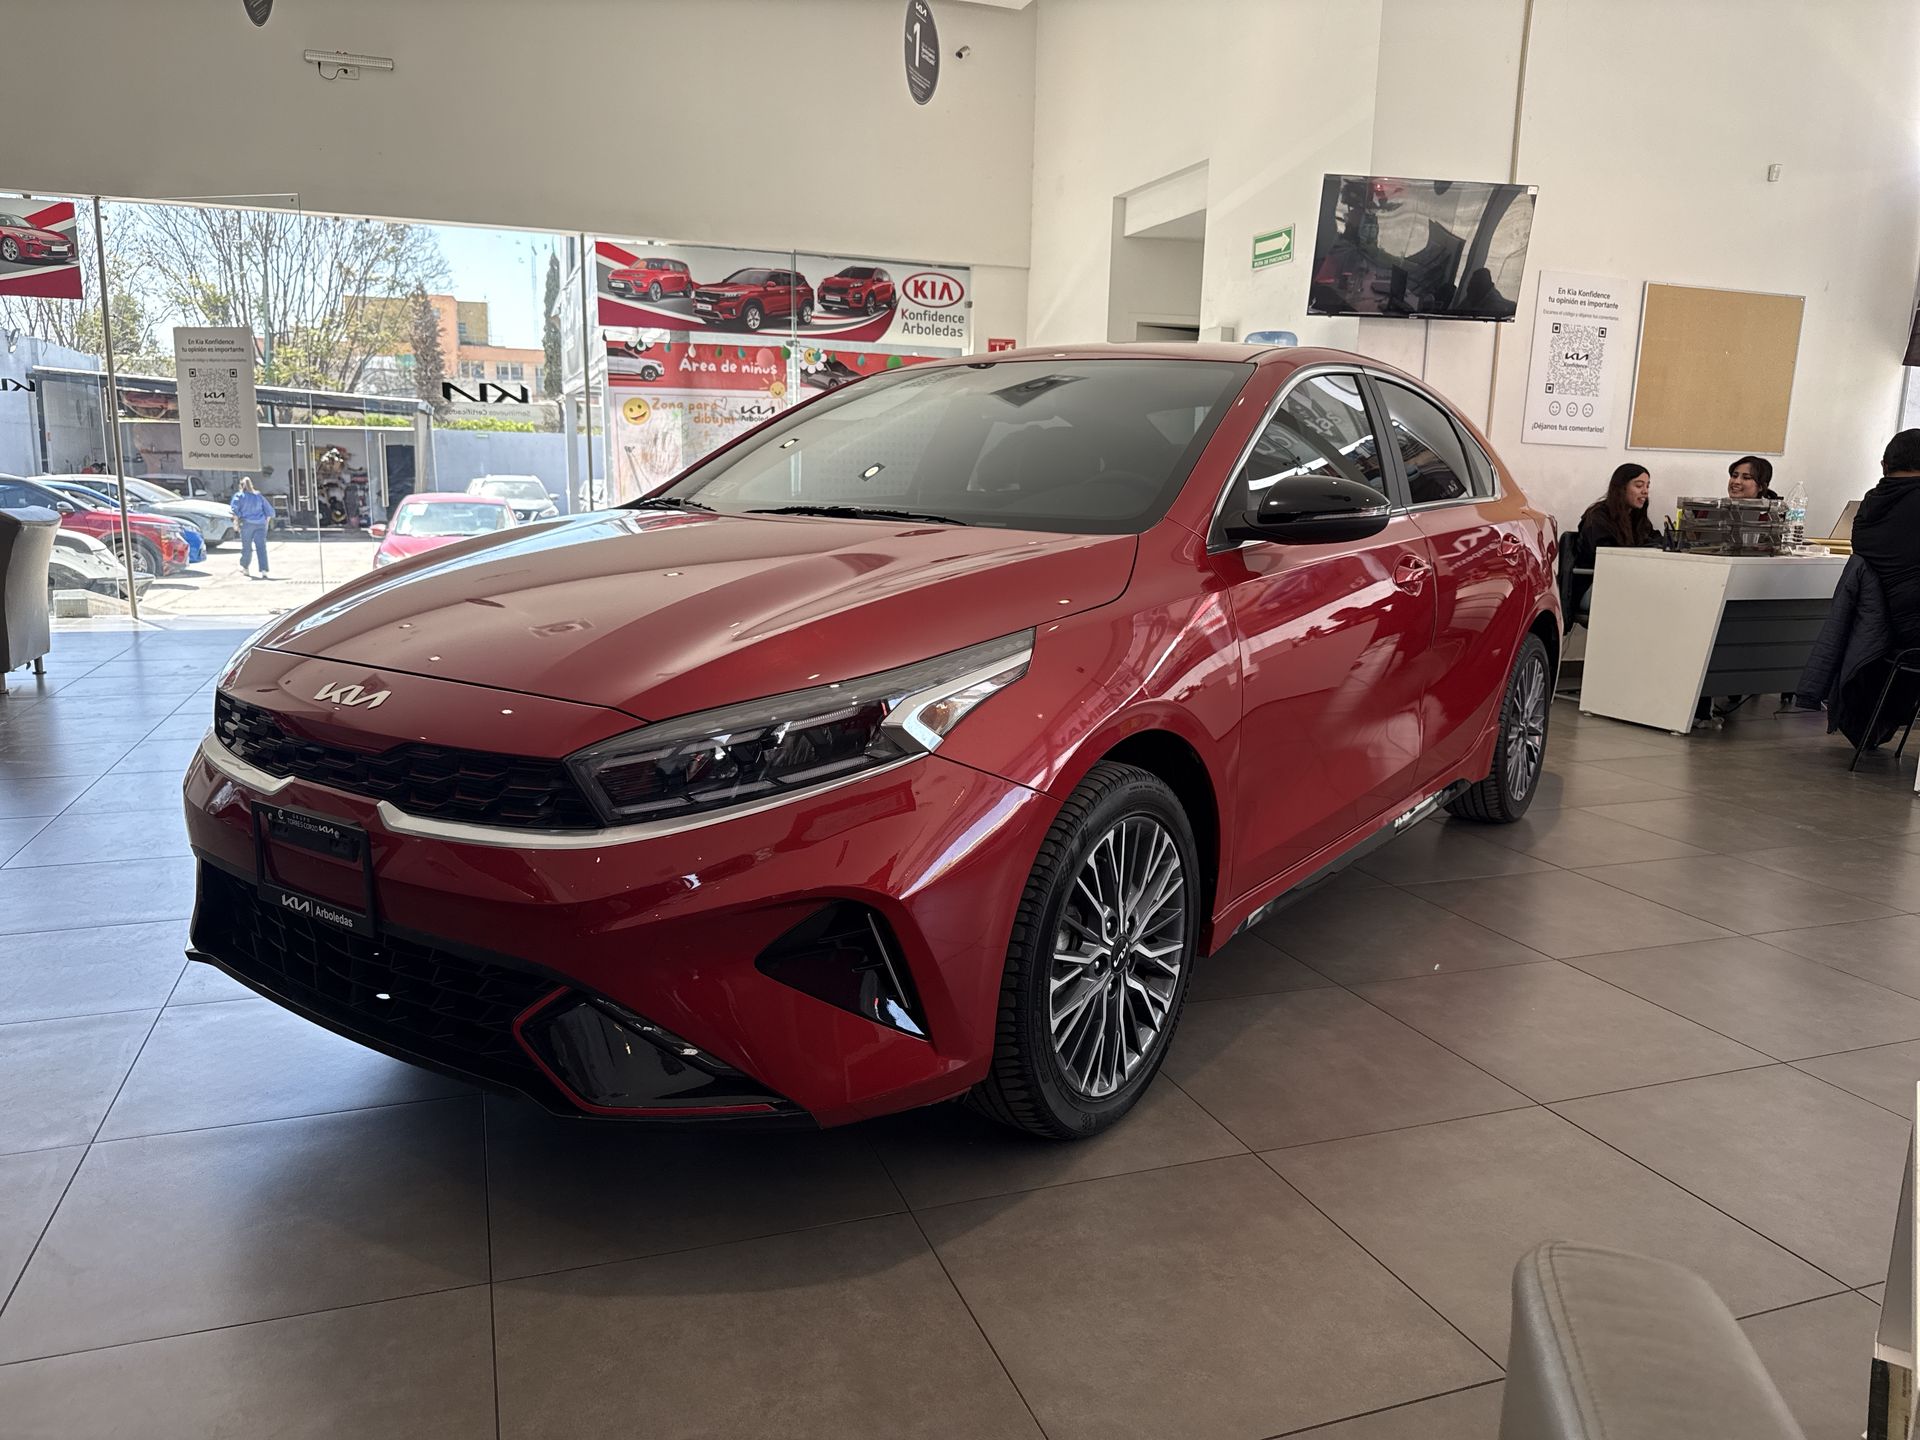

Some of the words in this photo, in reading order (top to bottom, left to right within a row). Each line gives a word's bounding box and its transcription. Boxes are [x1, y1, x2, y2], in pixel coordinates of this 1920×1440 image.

[913, 22, 921, 68] 1
[913, 279, 954, 301] KIA
[1557, 287, 1566, 295] En
[1567, 288, 1577, 296] Kia
[1578, 289, 1611, 300] Konfidence
[1556, 297, 1579, 305] opinión
[1587, 300, 1619, 310] importante
[901, 308, 965, 324] Konfidence
[902, 322, 964, 338] Arboledas
[679, 353, 717, 372] Área
[721, 360, 738, 373] de
[1565, 352, 1589, 361] KIA
[204, 391, 225, 399] KIA
[652, 397, 684, 410] Zona
[688, 402, 718, 414] para
[740, 405, 776, 415] KIA
[1531, 422, 1557, 431] ¡Déjanos
[1568, 424, 1605, 433] comentarios!
[313, 681, 392, 711] KIA
[281, 893, 310, 913] KIA
[315, 905, 353, 928] Arboledas
